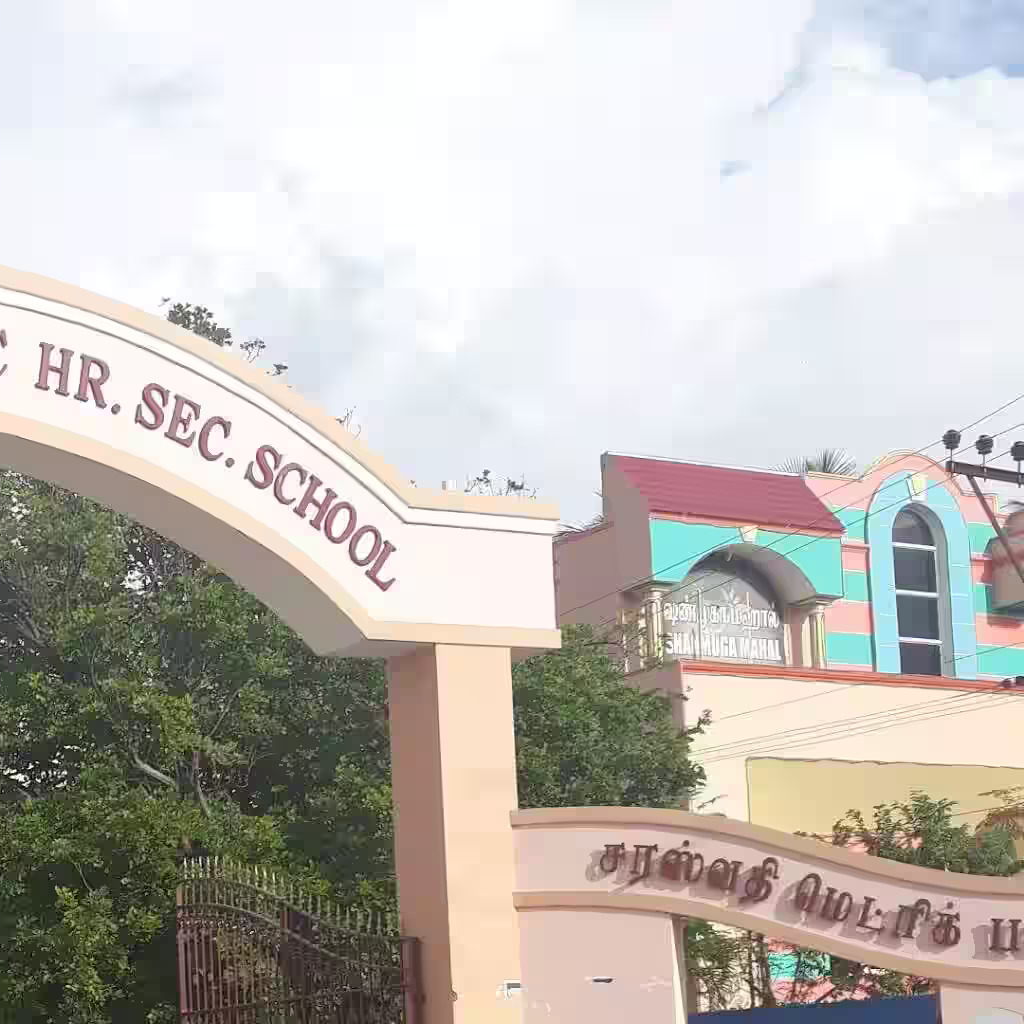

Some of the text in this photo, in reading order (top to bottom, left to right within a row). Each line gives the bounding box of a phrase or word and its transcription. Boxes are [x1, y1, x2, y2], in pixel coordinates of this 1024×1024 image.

[34, 341, 120, 415] HR.
[134, 382, 236, 469] SEC.
[243, 444, 401, 592] SCHOOL
